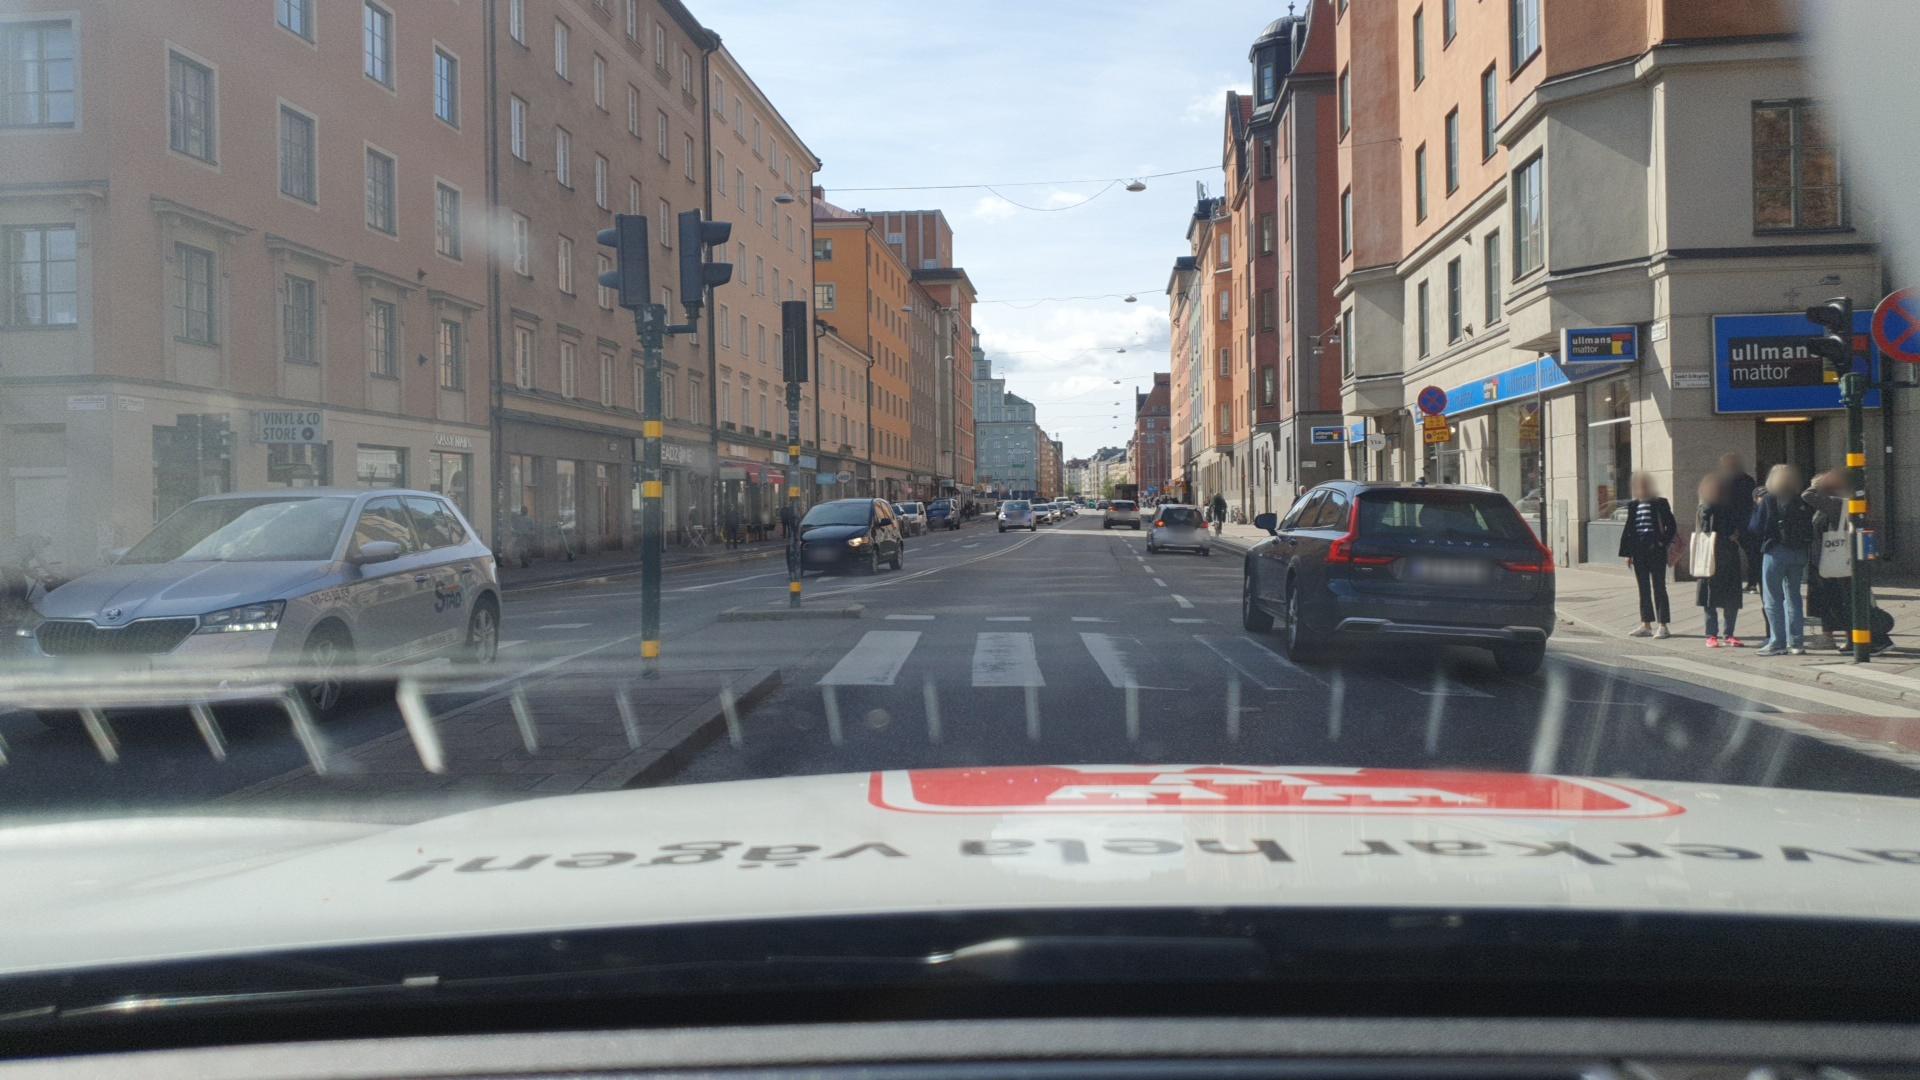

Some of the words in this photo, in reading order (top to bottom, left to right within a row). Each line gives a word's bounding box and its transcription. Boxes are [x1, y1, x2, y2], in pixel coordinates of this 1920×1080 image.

[1572, 336, 1611, 345] ullmans
[1572, 345, 1598, 353] mattor
[1733, 364, 1791, 381] mattor
[263, 412, 295, 425] VINYL
[297, 412, 304, 425] &
[306, 412, 320, 426] CD
[263, 427, 297, 441] STORE
[1410, 538, 1490, 547] VOLVO
[959, 839, 1296, 863] hela
[386, 841, 907, 882] vägen!
